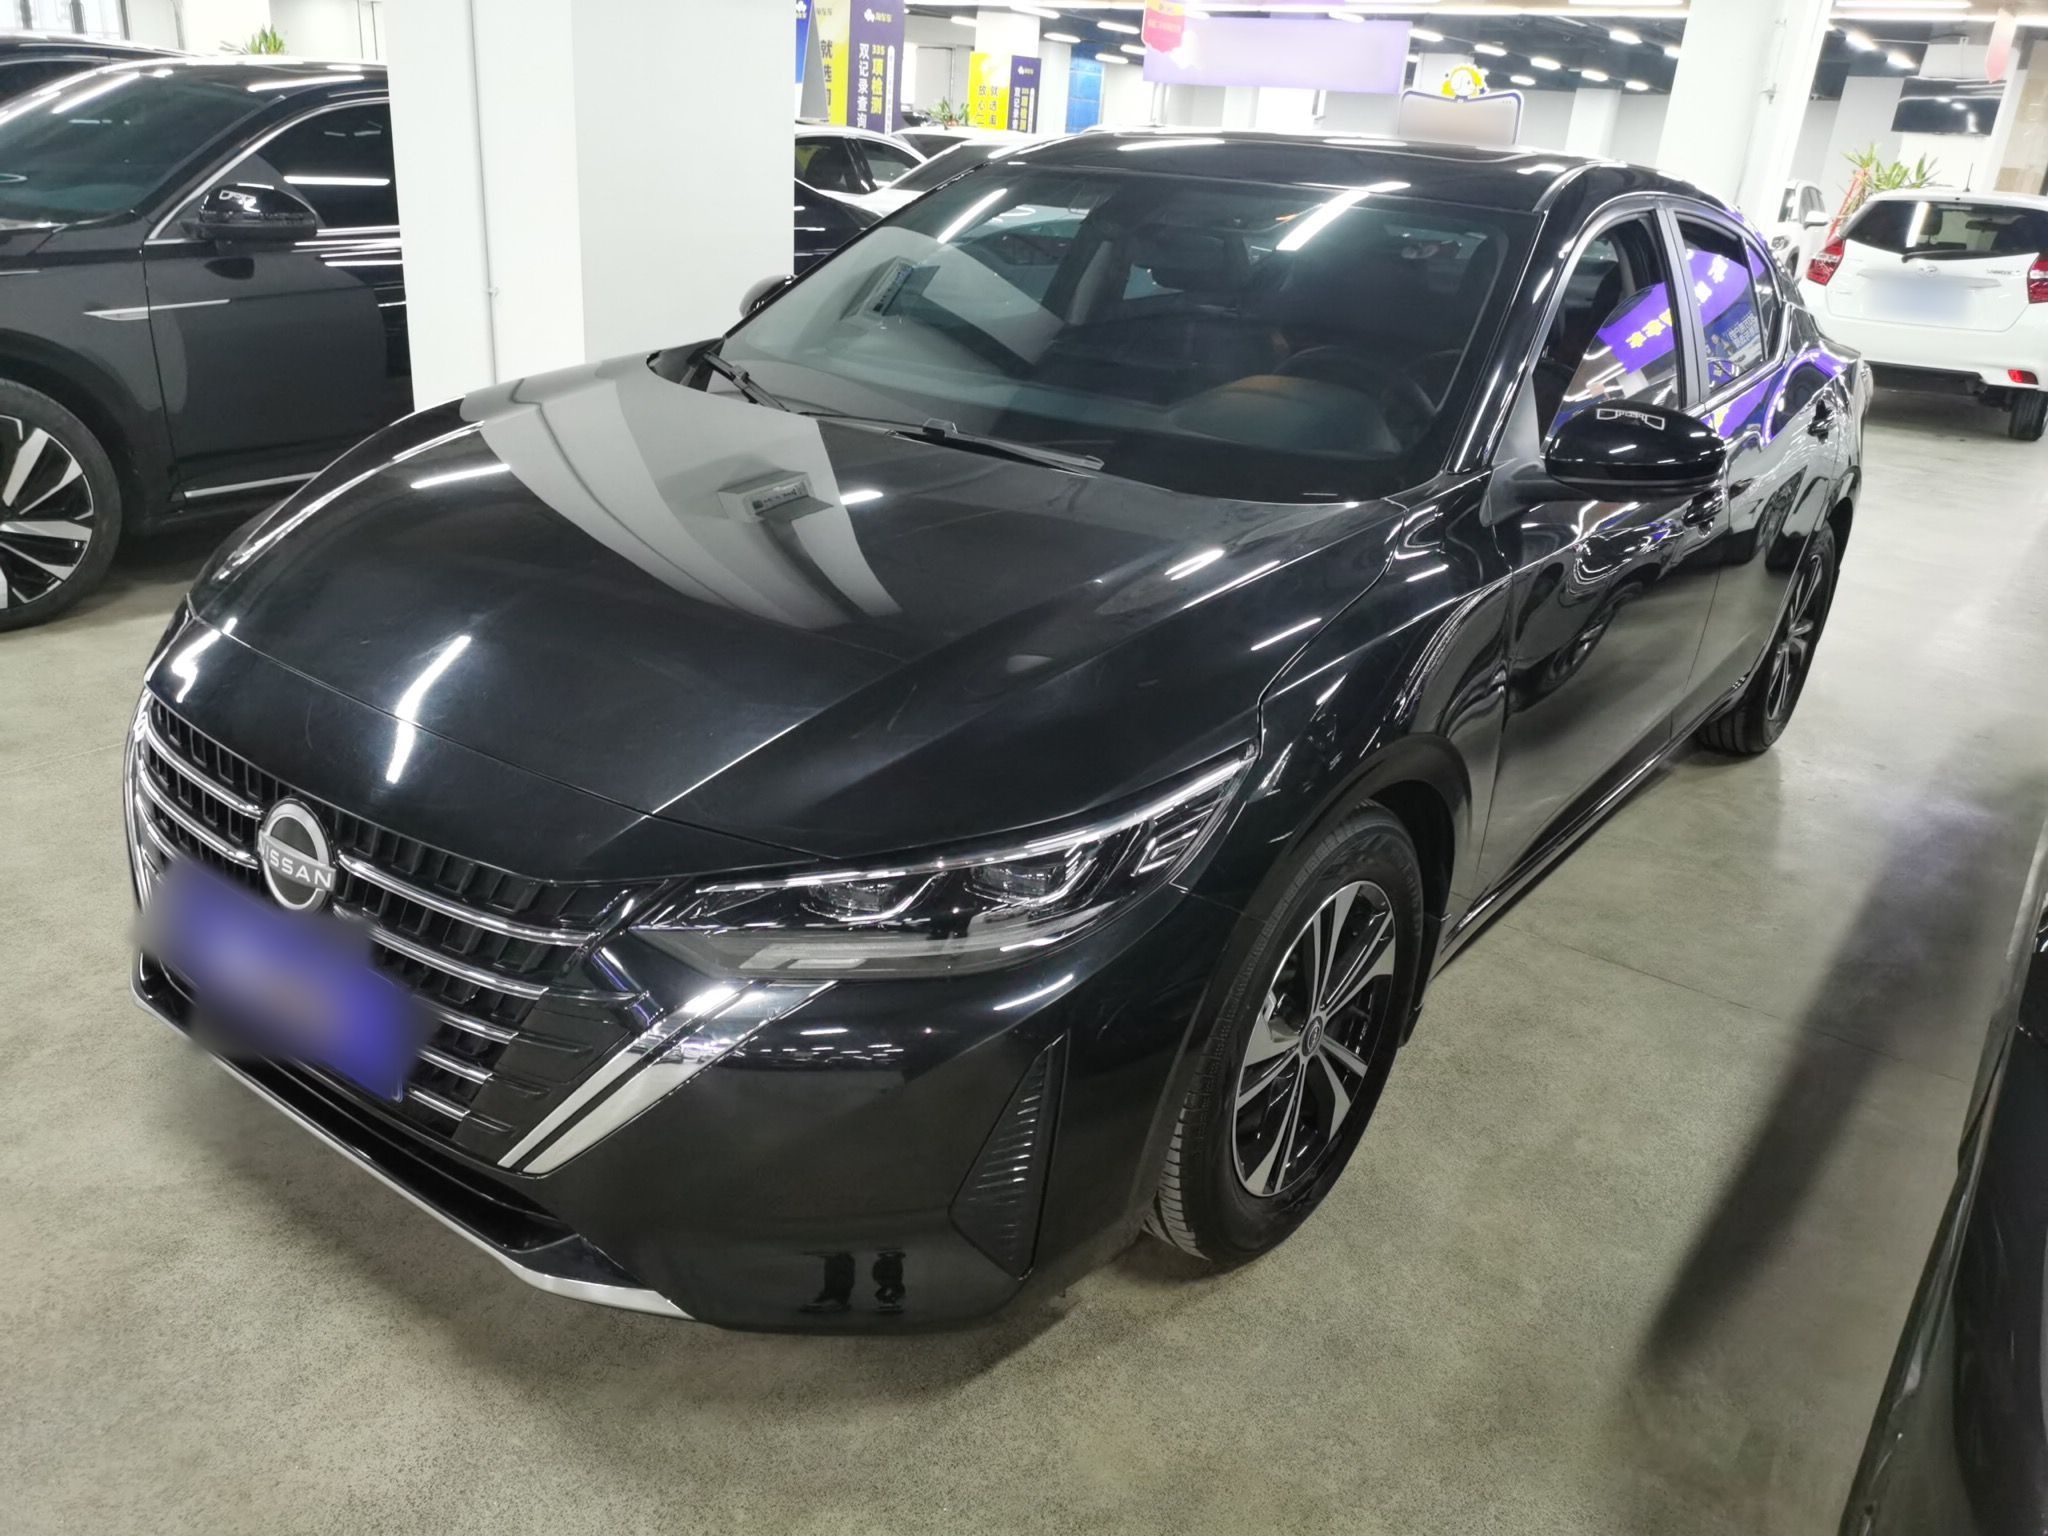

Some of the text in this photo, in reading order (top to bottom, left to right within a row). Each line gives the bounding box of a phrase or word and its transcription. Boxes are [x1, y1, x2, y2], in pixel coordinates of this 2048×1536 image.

[857, 43, 870, 128] 双记录查询
